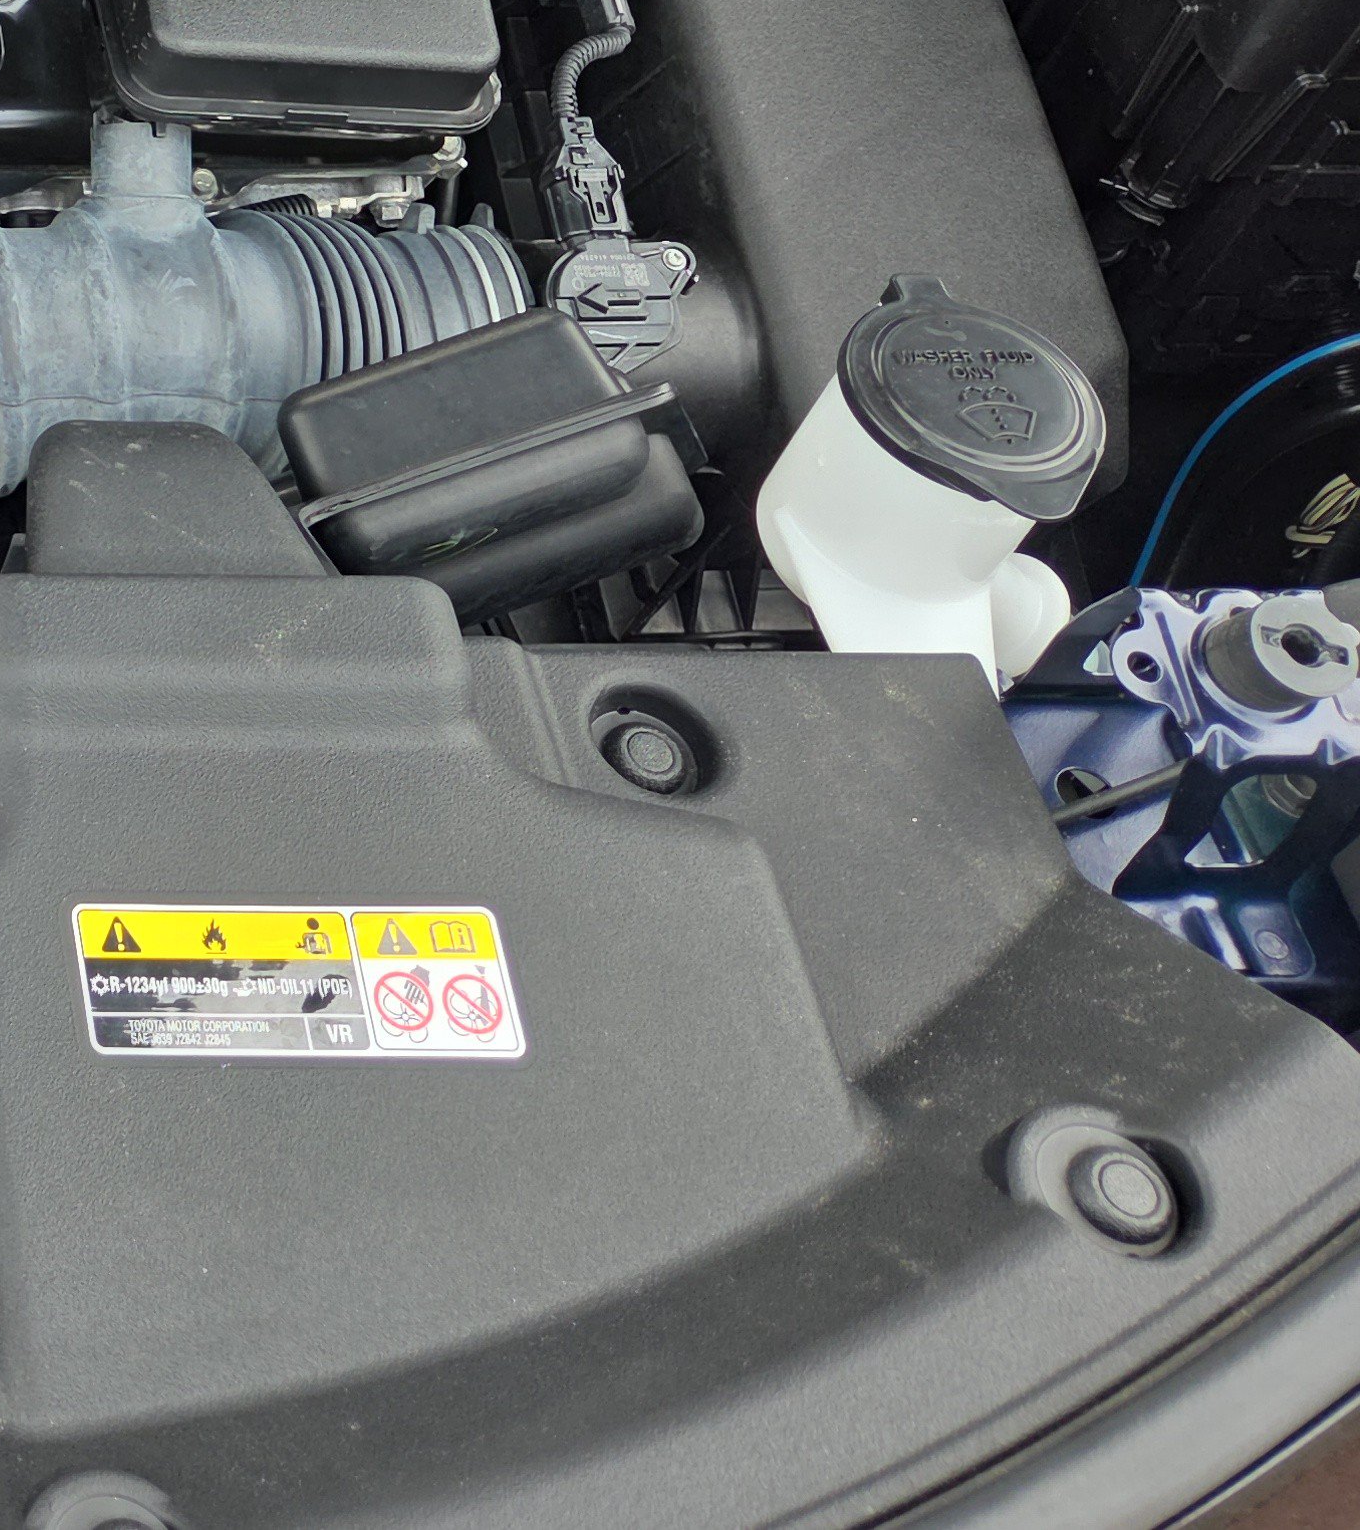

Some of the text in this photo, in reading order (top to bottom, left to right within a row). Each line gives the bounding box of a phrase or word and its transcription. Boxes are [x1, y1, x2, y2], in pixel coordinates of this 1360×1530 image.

[893, 348, 1035, 366] WASHER FLUID
[949, 365, 997, 380] ONLY
[109, 976, 353, 999] R-1234yf 900±30g ND-OIL11 (POE)
[127, 1019, 270, 1033] TOYOTA MOTOR CORPORATION
[130, 1033, 150, 1045] SAE
[175, 1033, 202, 1046] J2842
[204, 1034, 232, 1046] J2845
[325, 1024, 354, 1045] VR
